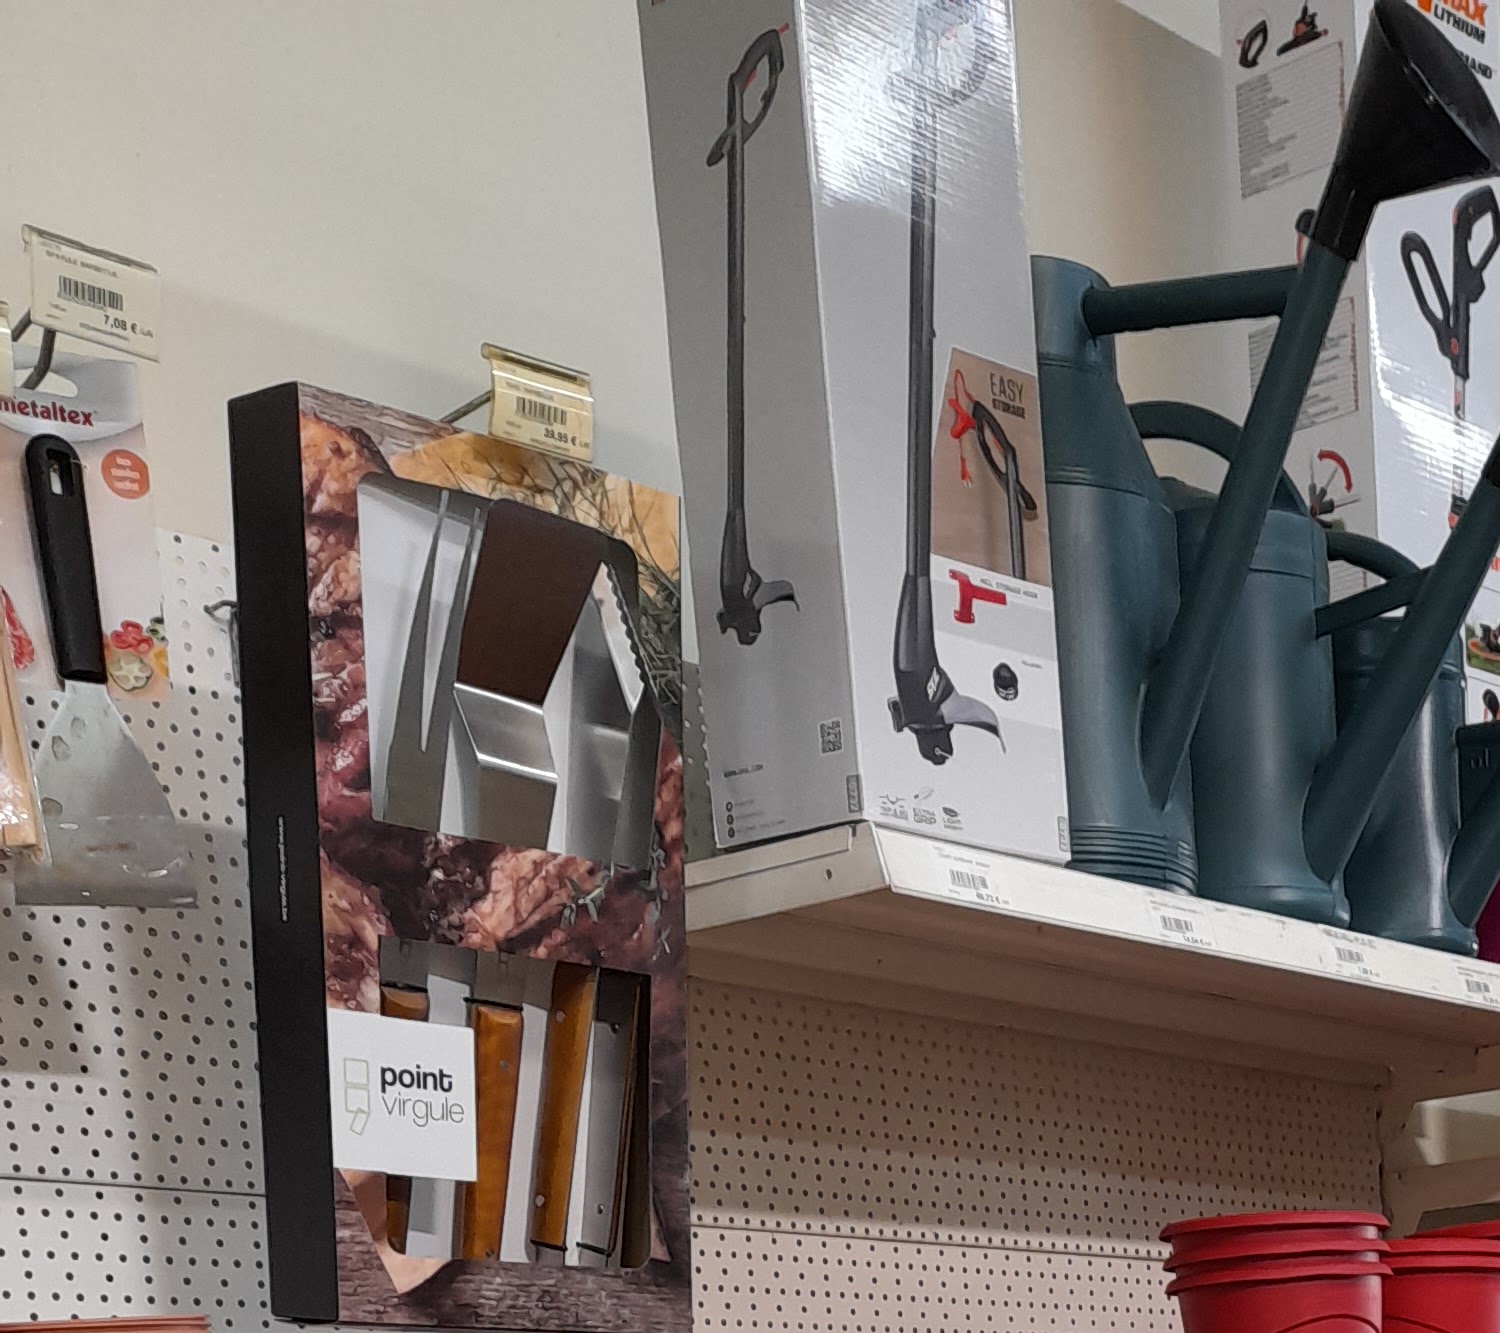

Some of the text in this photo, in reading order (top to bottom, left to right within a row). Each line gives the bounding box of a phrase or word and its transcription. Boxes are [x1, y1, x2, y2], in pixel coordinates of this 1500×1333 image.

[1434, 4, 1485, 44] LITHIUM
[990, 372, 1023, 404] EASY
[380, 1064, 453, 1094] point
[382, 1092, 465, 1127] virgule
